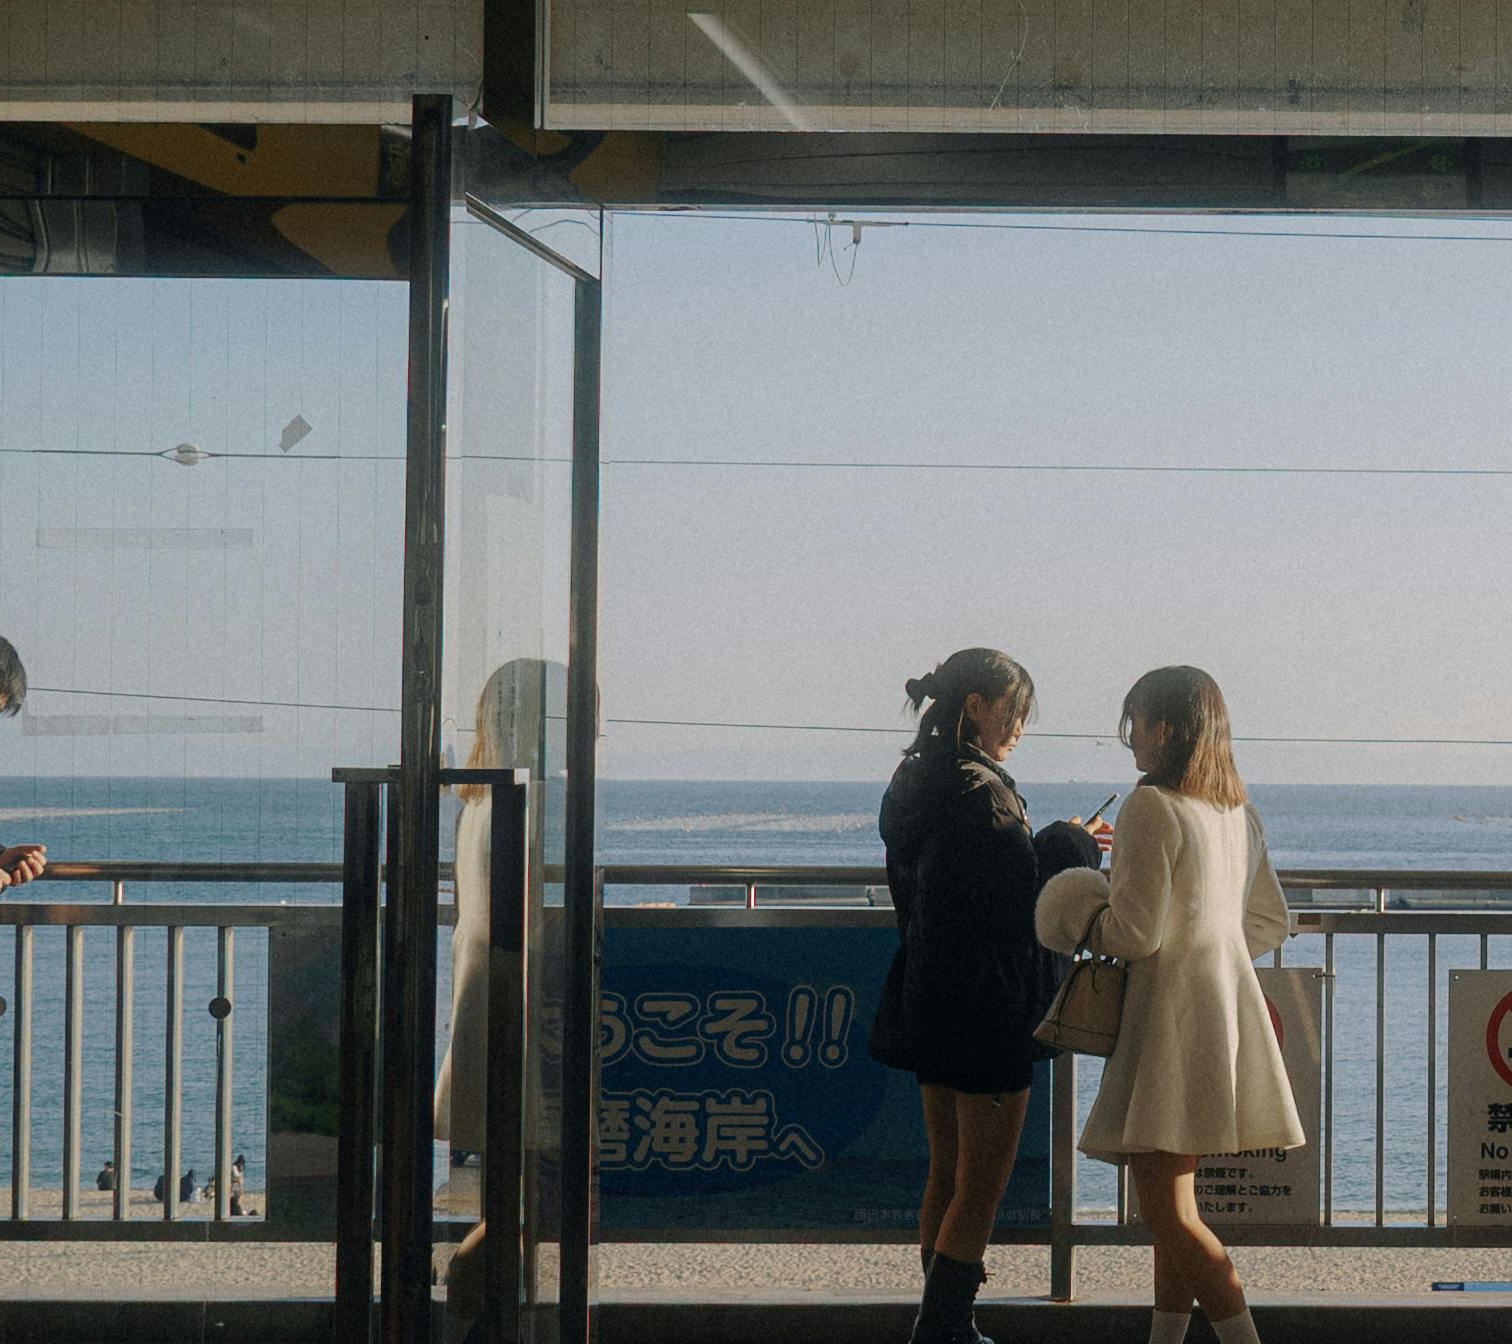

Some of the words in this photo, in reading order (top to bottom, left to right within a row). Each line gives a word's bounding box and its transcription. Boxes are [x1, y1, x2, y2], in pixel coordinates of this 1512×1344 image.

[598, 985, 855, 1069] うこそ!!
[598, 1088, 825, 1172] 海岸へ
[1480, 1142, 1509, 1160] No
